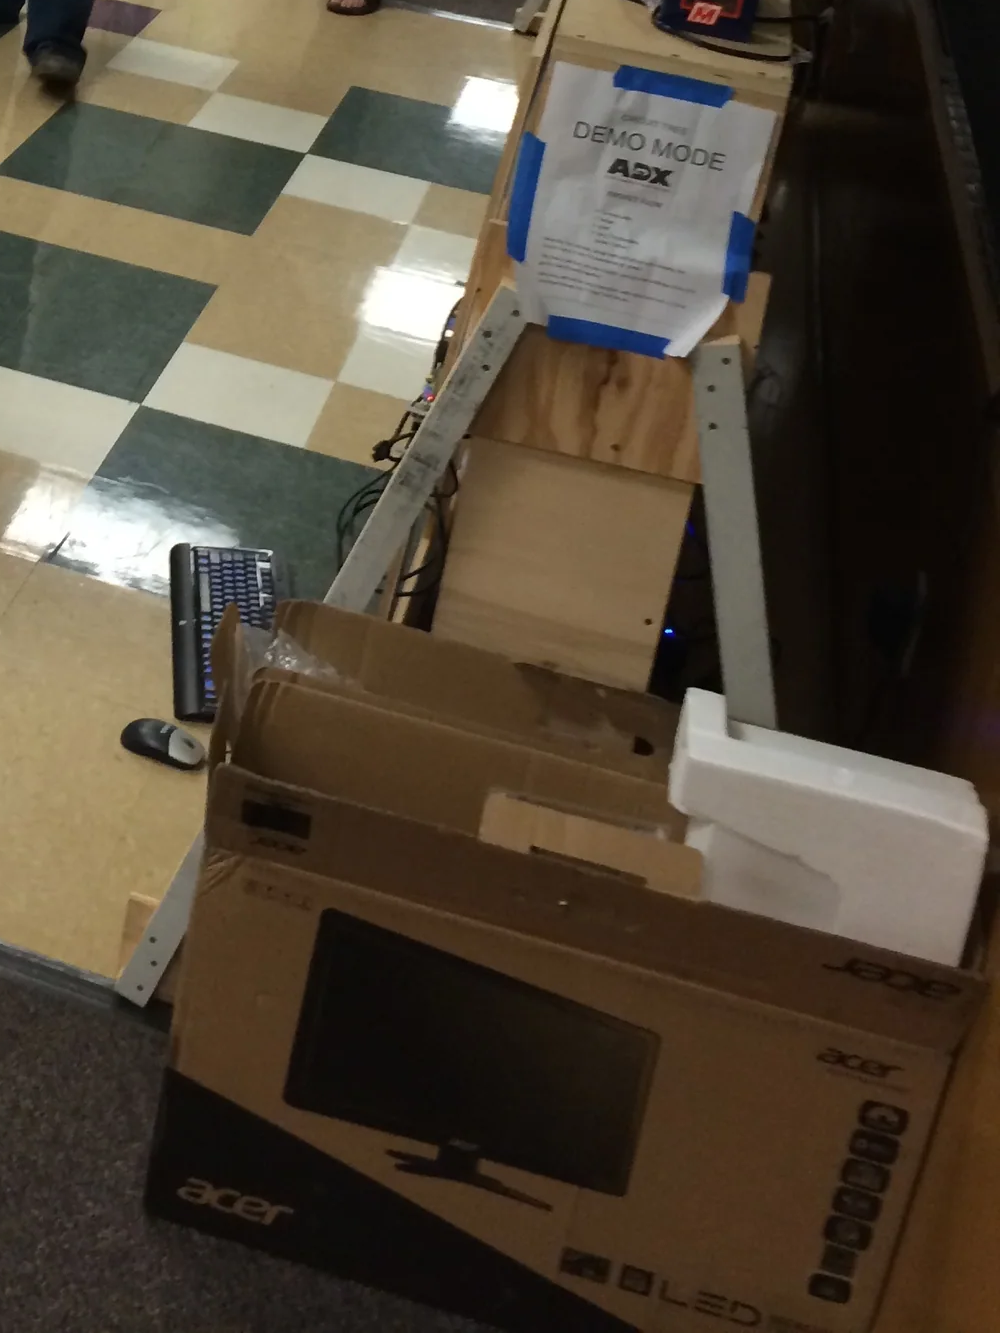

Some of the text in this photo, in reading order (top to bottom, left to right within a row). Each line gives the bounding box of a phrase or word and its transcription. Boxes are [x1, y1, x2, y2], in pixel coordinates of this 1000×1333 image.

[573, 121, 646, 151] DEMO
[651, 138, 727, 171] MODE
[821, 957, 962, 1000] acer
[816, 1047, 906, 1078] acer
[176, 1176, 295, 1226] acer
